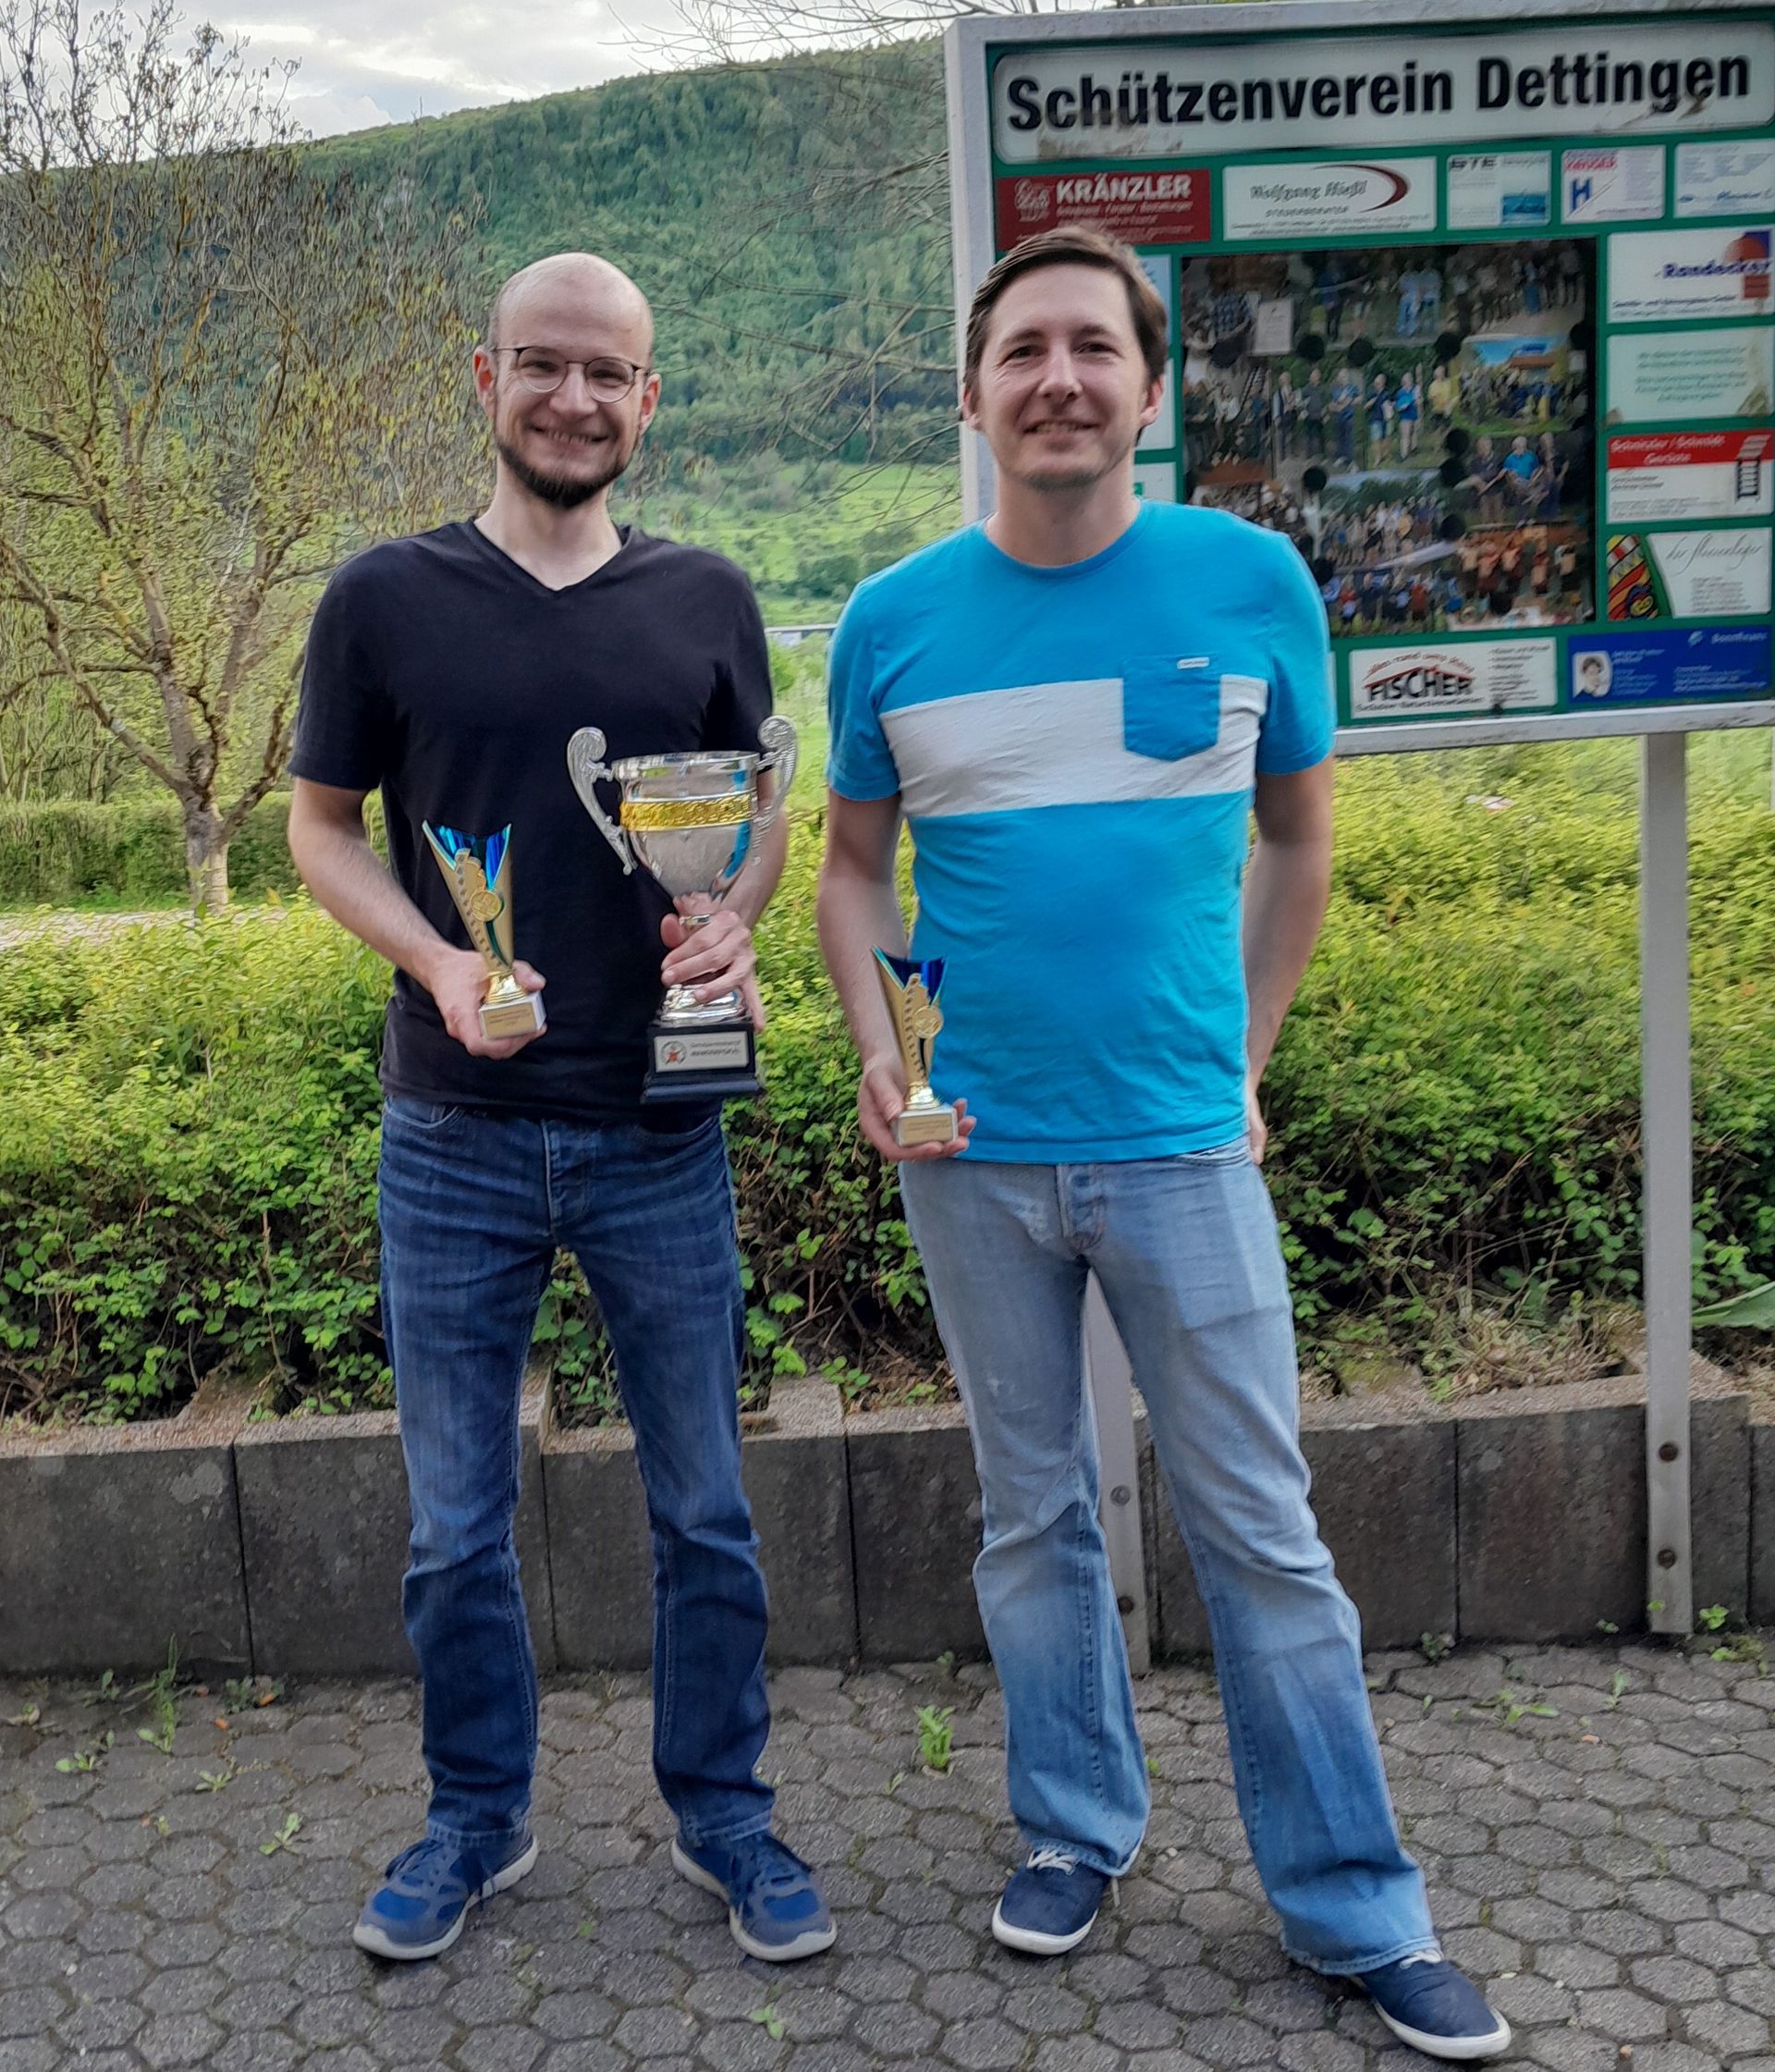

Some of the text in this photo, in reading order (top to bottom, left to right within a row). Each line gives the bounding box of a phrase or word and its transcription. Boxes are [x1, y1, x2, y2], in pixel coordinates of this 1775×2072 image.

[1007, 54, 1750, 130] Schützenverein Dettingen
[1056, 173, 1192, 204] KRÄNZLER
[1368, 669, 1473, 701] FISCHER
